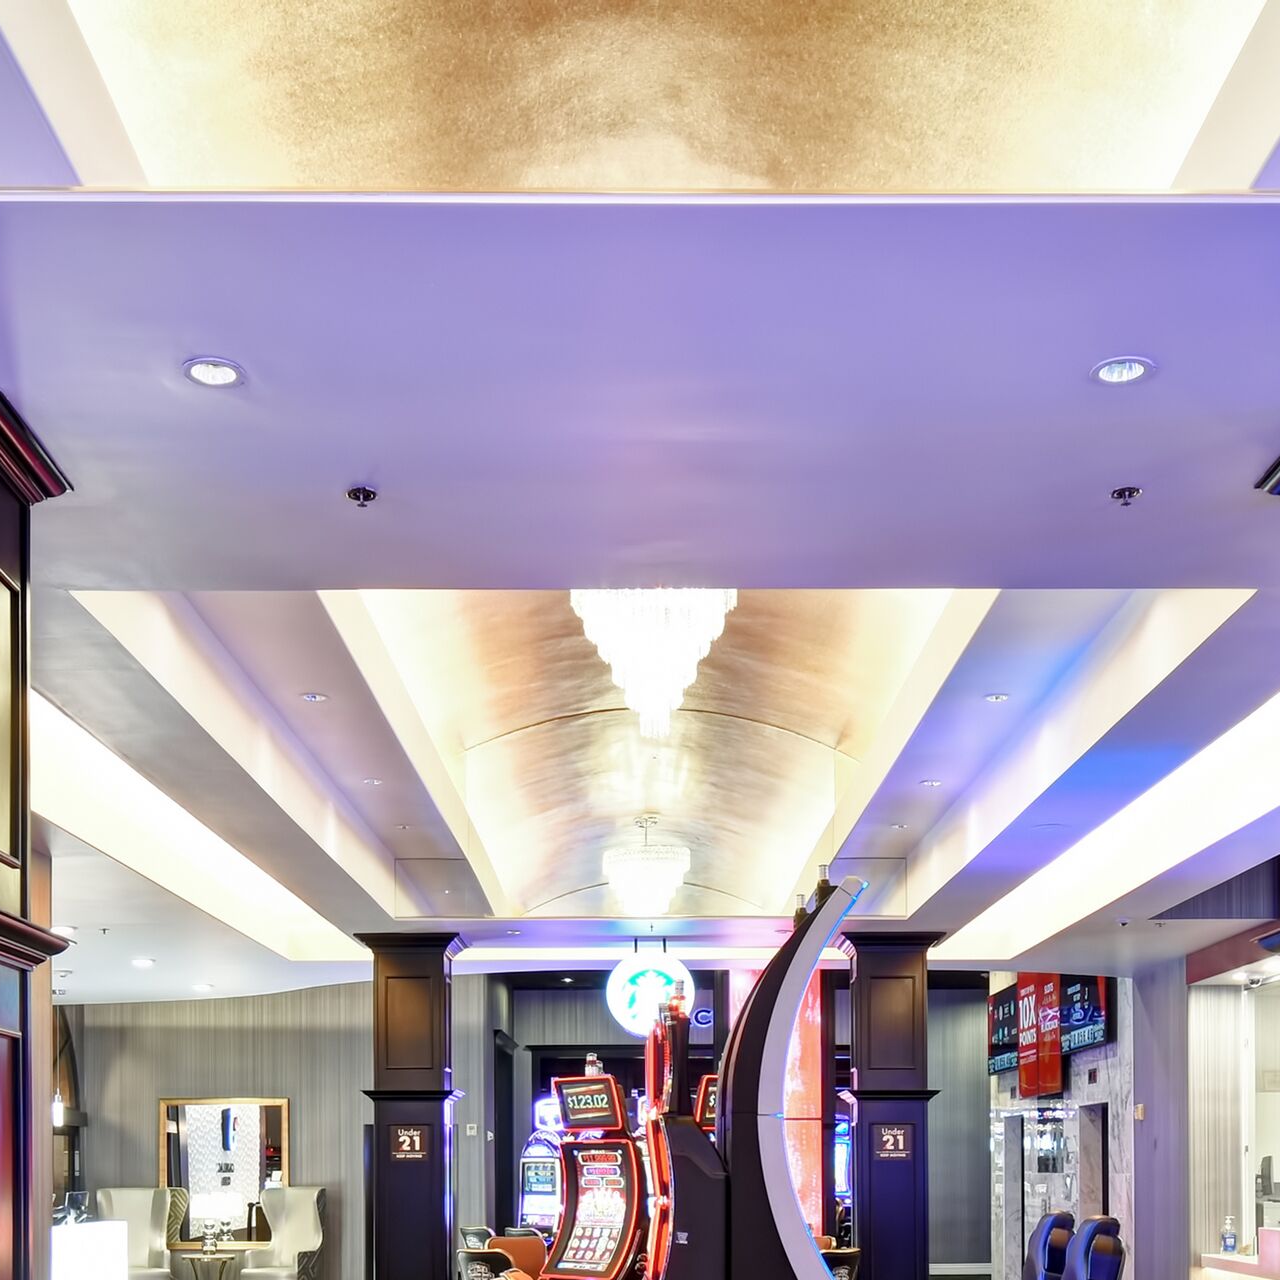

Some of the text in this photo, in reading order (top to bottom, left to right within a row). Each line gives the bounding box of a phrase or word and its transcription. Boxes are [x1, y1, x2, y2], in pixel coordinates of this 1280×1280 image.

[1019, 994, 1037, 1030] 10X
[567, 1093, 609, 1109] $123.02
[397, 1128, 421, 1136] Under
[881, 1127, 905, 1135] Under
[399, 1135, 420, 1151] 21
[882, 1134, 904, 1150] 21
